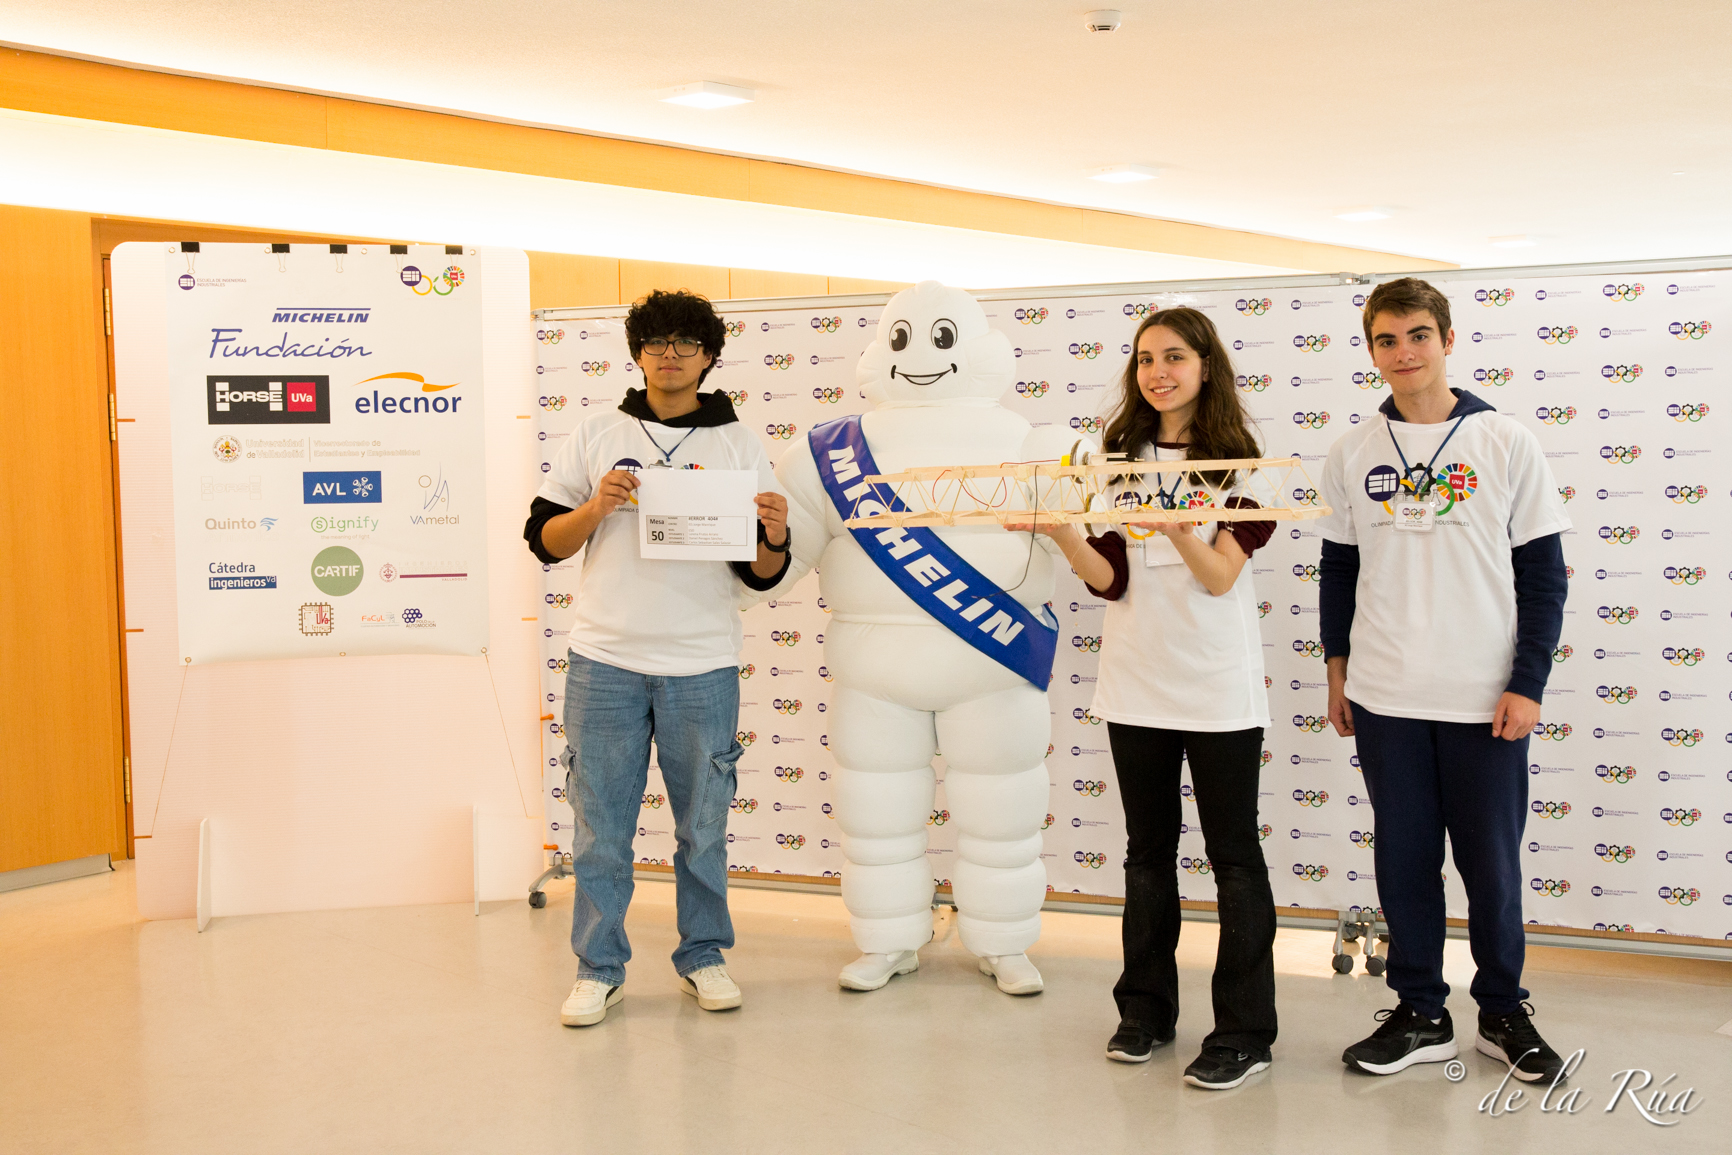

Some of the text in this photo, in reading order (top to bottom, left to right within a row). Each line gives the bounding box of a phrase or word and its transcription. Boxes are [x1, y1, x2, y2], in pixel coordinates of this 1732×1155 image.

[272, 312, 370, 323] MICHELIN
[209, 328, 372, 358] Fundación
[291, 393, 313, 403] UVa
[355, 390, 462, 414] elecnor
[246, 439, 304, 448] Universidad
[312, 483, 346, 496] AVL
[205, 518, 256, 530] Quinto
[652, 531, 664, 541] 50
[209, 562, 255, 574] Cátedra
[314, 565, 360, 577] CARTIF
[210, 577, 266, 590] ingenieros
